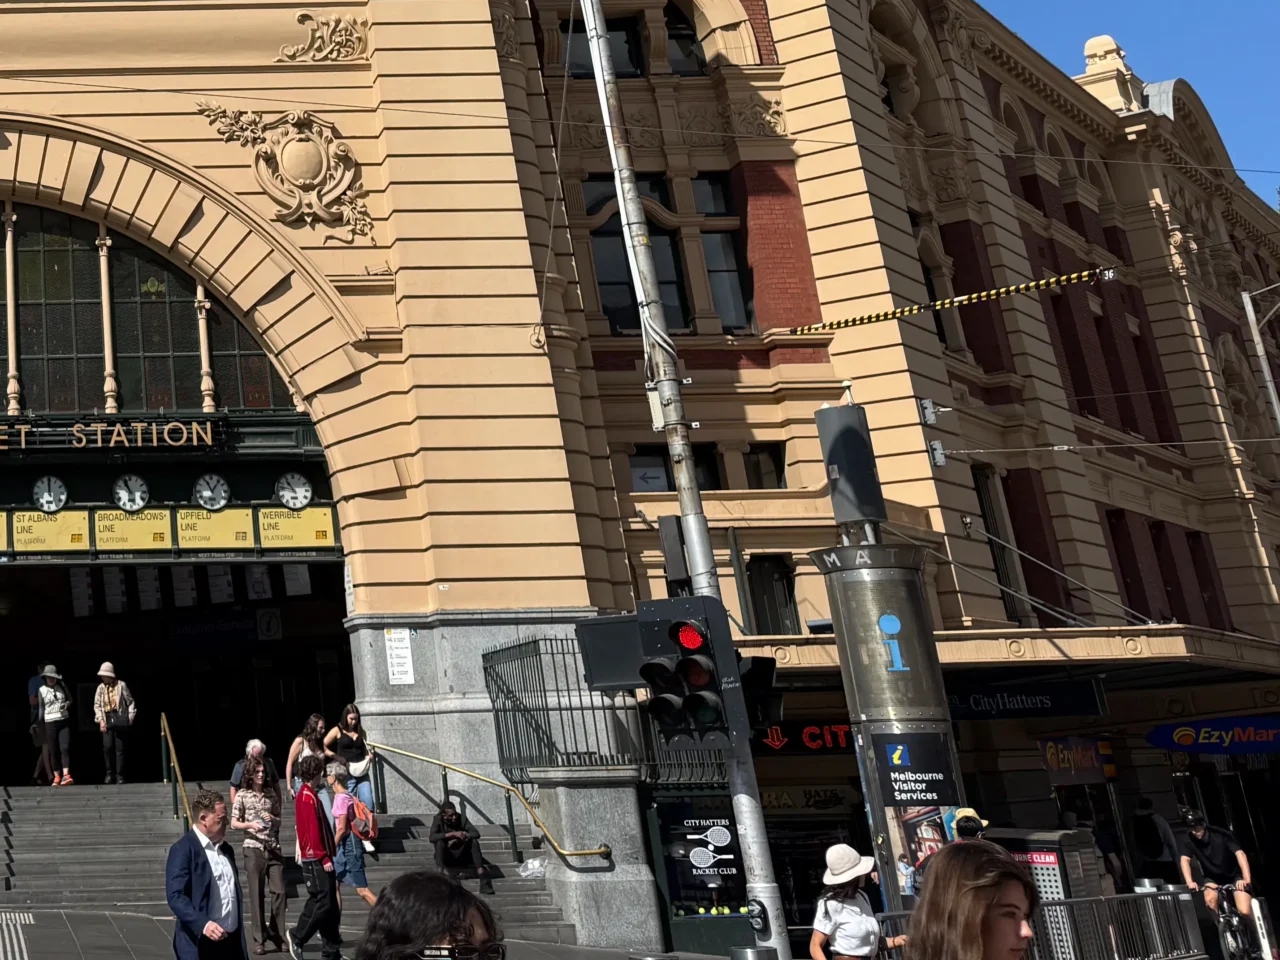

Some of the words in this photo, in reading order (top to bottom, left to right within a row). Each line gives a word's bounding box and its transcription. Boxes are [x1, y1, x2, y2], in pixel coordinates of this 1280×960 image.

[1104, 269, 1114, 280] 36
[72, 421, 214, 448] STATION
[16, 514, 26, 523] ST
[27, 513, 58, 523] ALBANS
[97, 511, 164, 522] BROADMEADOWS
[180, 511, 212, 520] UPFIELD
[261, 510, 302, 520] WERRIBEE
[16, 525, 33, 534] LINE
[98, 524, 116, 533] LINE
[180, 523, 198, 531] LINE
[262, 522, 280, 531] LINE
[99, 536, 128, 544] PLATFORM
[181, 535, 211, 543] PLATFORM
[1197, 726, 1280, 747] EzyMar
[890, 771, 944, 781] Melbourne
[891, 781, 927, 790] Visitor
[894, 791, 938, 800] Services
[684, 819, 700, 827] CITY
[1033, 854, 1055, 863] CLEAN
